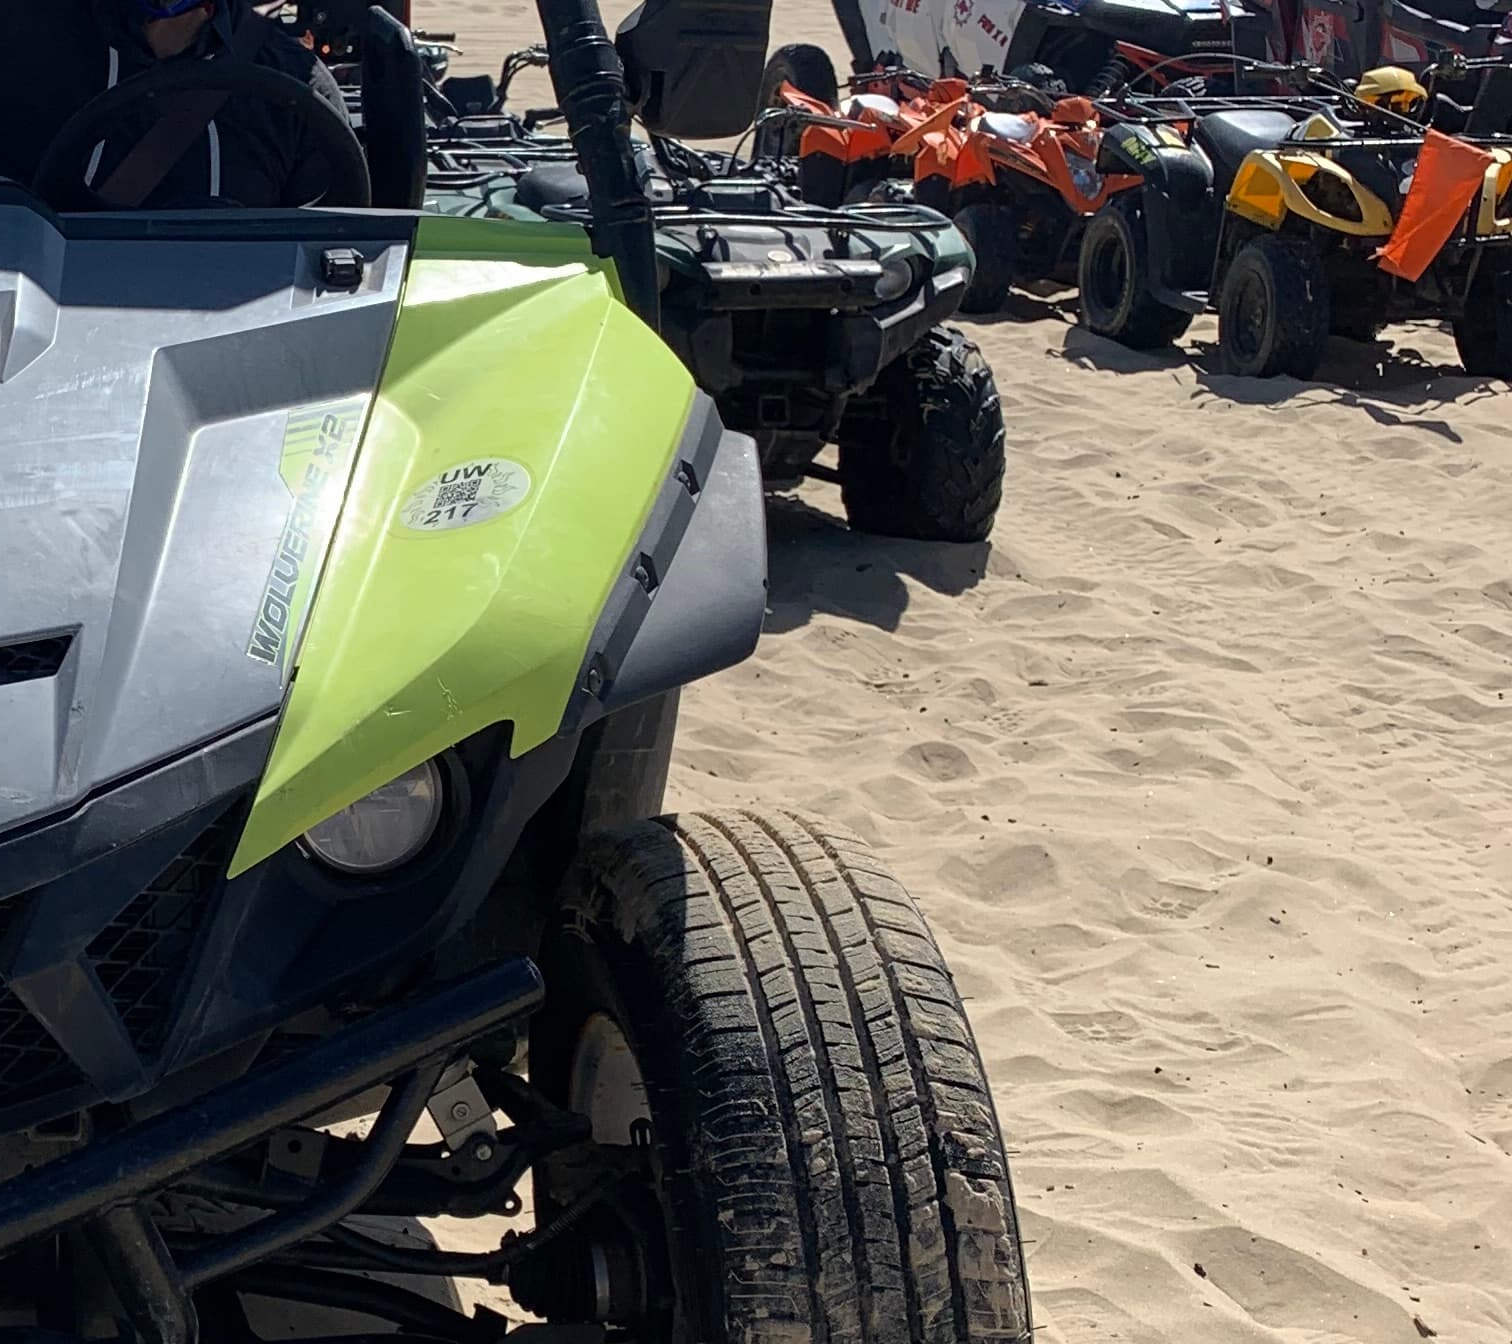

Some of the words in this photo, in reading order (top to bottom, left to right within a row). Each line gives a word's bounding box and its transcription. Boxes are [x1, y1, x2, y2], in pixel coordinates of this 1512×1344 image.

[440, 463, 492, 484] UW
[423, 502, 479, 525] 217
[249, 463, 328, 664] WOLVERINE
[313, 414, 345, 464] X2
